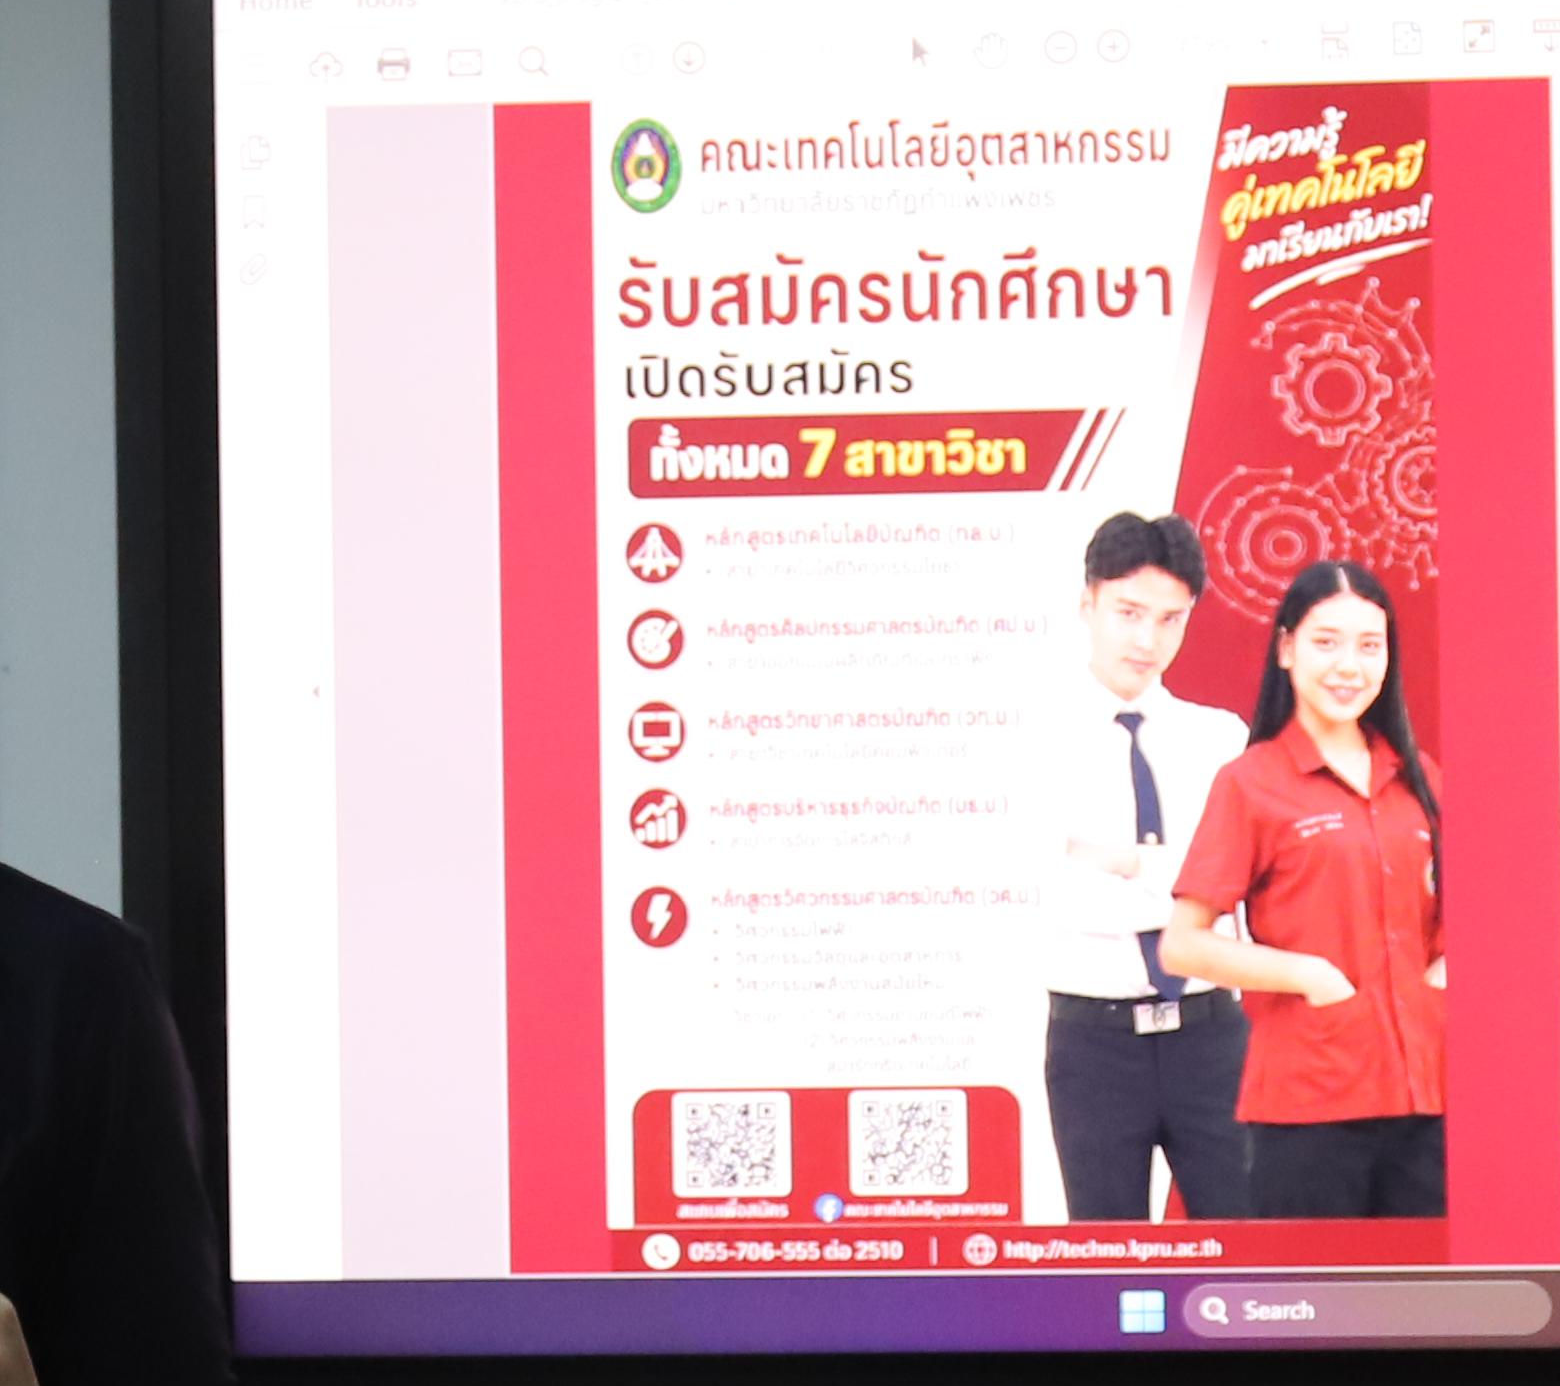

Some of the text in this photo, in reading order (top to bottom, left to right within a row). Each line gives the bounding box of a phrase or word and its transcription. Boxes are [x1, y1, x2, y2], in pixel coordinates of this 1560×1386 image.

[700, 120, 1172, 181] คณะเทคโนโลยีอุตสาหกรรม
[1217, 105, 1348, 172] มีความรู้
[1220, 139, 1427, 241] คู่เทคโนโลยี
[1240, 192, 1433, 272] มาเรียนกับเรา!
[617, 245, 1174, 331] รับสมัครนักศึกษา
[625, 347, 915, 399] เปิดรับสมัคร
[649, 423, 1027, 482] ทั้งหมด 7 สาขาวิชา
[687, 1239, 905, 1263] 055-706-555 ต่อ 2510
[1003, 1238, 1224, 1263] http://techno.kpru.ac.th
[1242, 1297, 1317, 1323] Search
